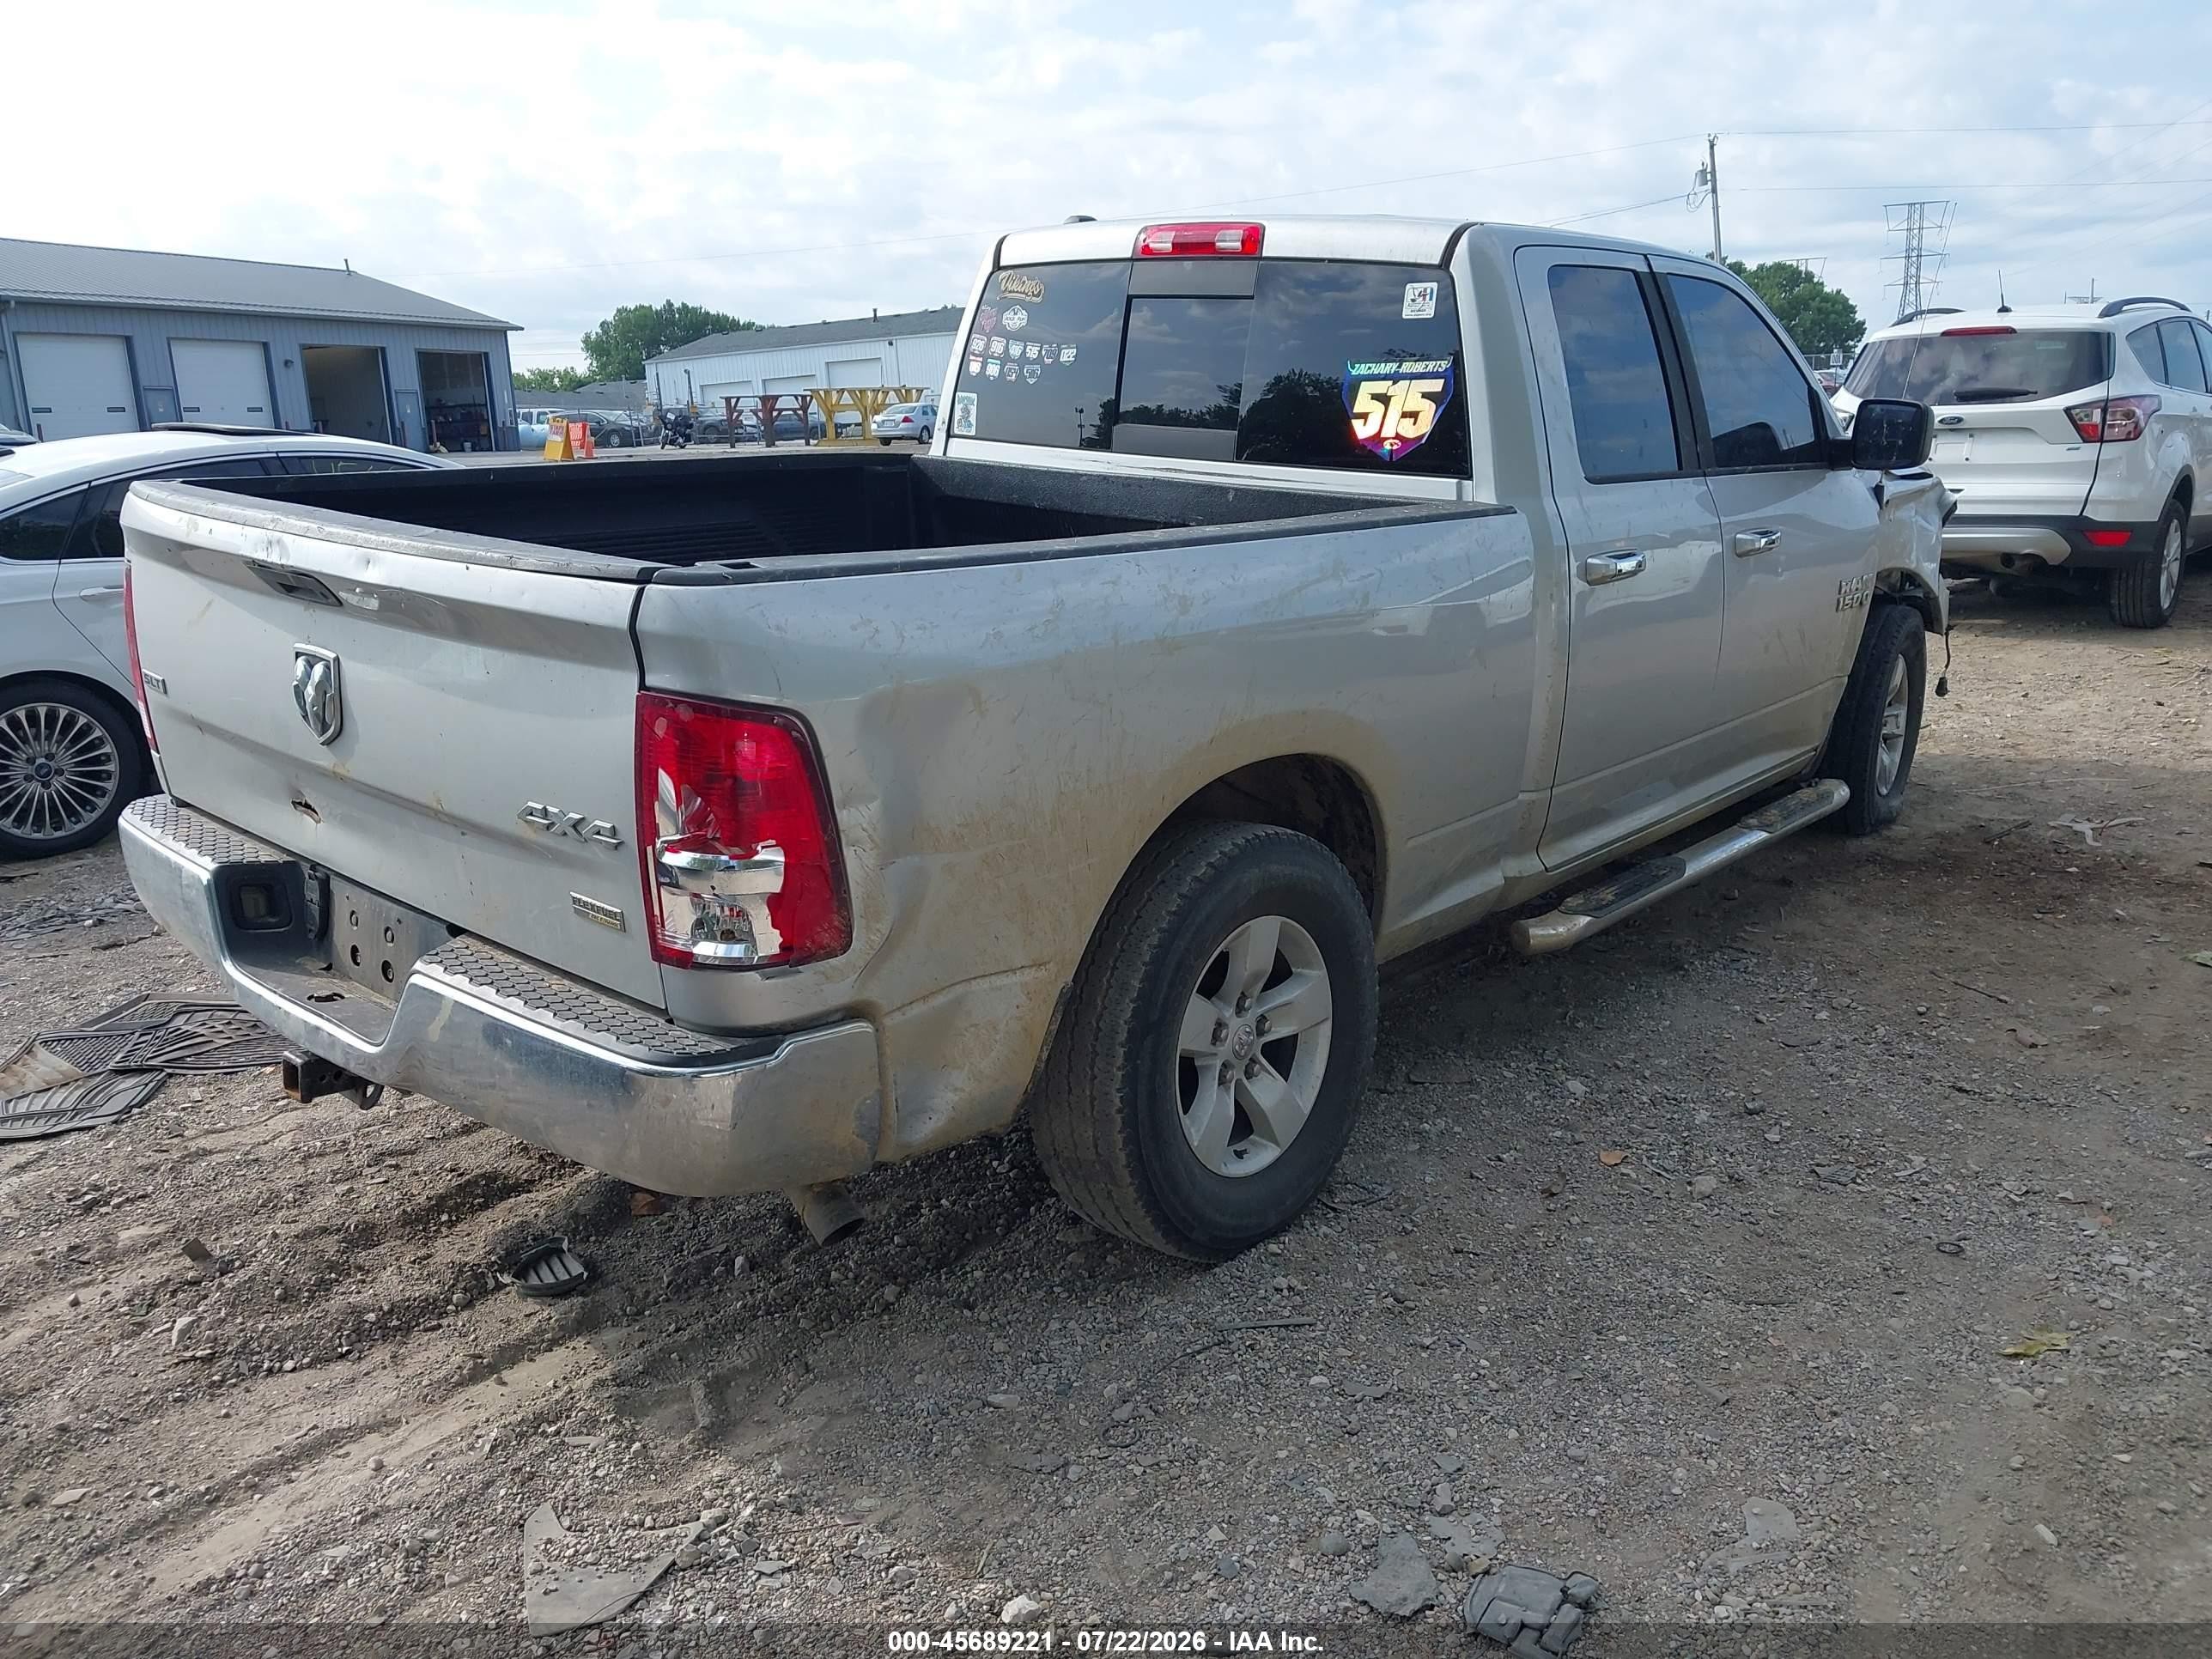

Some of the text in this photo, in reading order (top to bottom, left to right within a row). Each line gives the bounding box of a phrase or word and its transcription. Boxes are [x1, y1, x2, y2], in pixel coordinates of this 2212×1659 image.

[998, 270, 1045, 303] Vikings
[971, 337, 985, 351] 926
[990, 340, 1005, 354] 916
[1025, 345, 1040, 359] 515
[1351, 379, 1445, 440] 515
[143, 673, 161, 690] SLT
